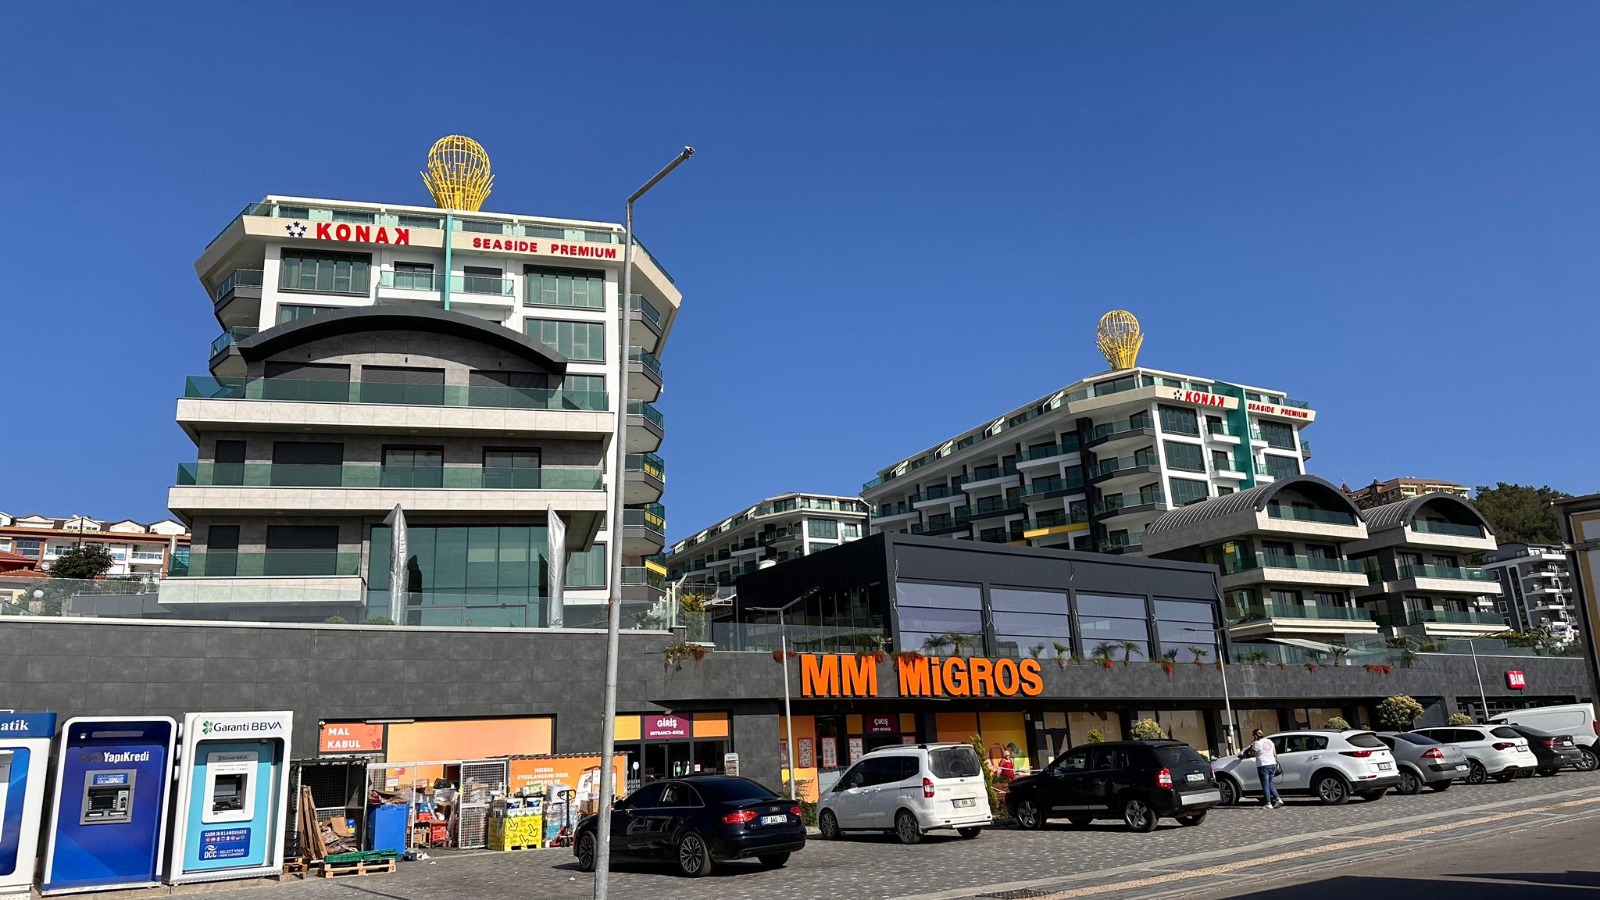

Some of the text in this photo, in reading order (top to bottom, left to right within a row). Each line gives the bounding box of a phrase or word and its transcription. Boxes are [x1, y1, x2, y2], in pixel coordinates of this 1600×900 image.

[316, 222, 410, 246] KONAK
[472, 237, 617, 259] SEASIDE PREMIUM
[1185, 391, 1225, 408] KONAK
[1248, 403, 1308, 419] SEASIDE PREMIUM
[801, 654, 878, 696] MM
[0, 719, 29, 731] atik
[213, 721, 282, 732] Garanti BBVA
[656, 717, 677, 729] GİRİŞ
[328, 727, 350, 736] MAL
[327, 740, 361, 749] KABUL
[204, 851, 217, 859] DCC
